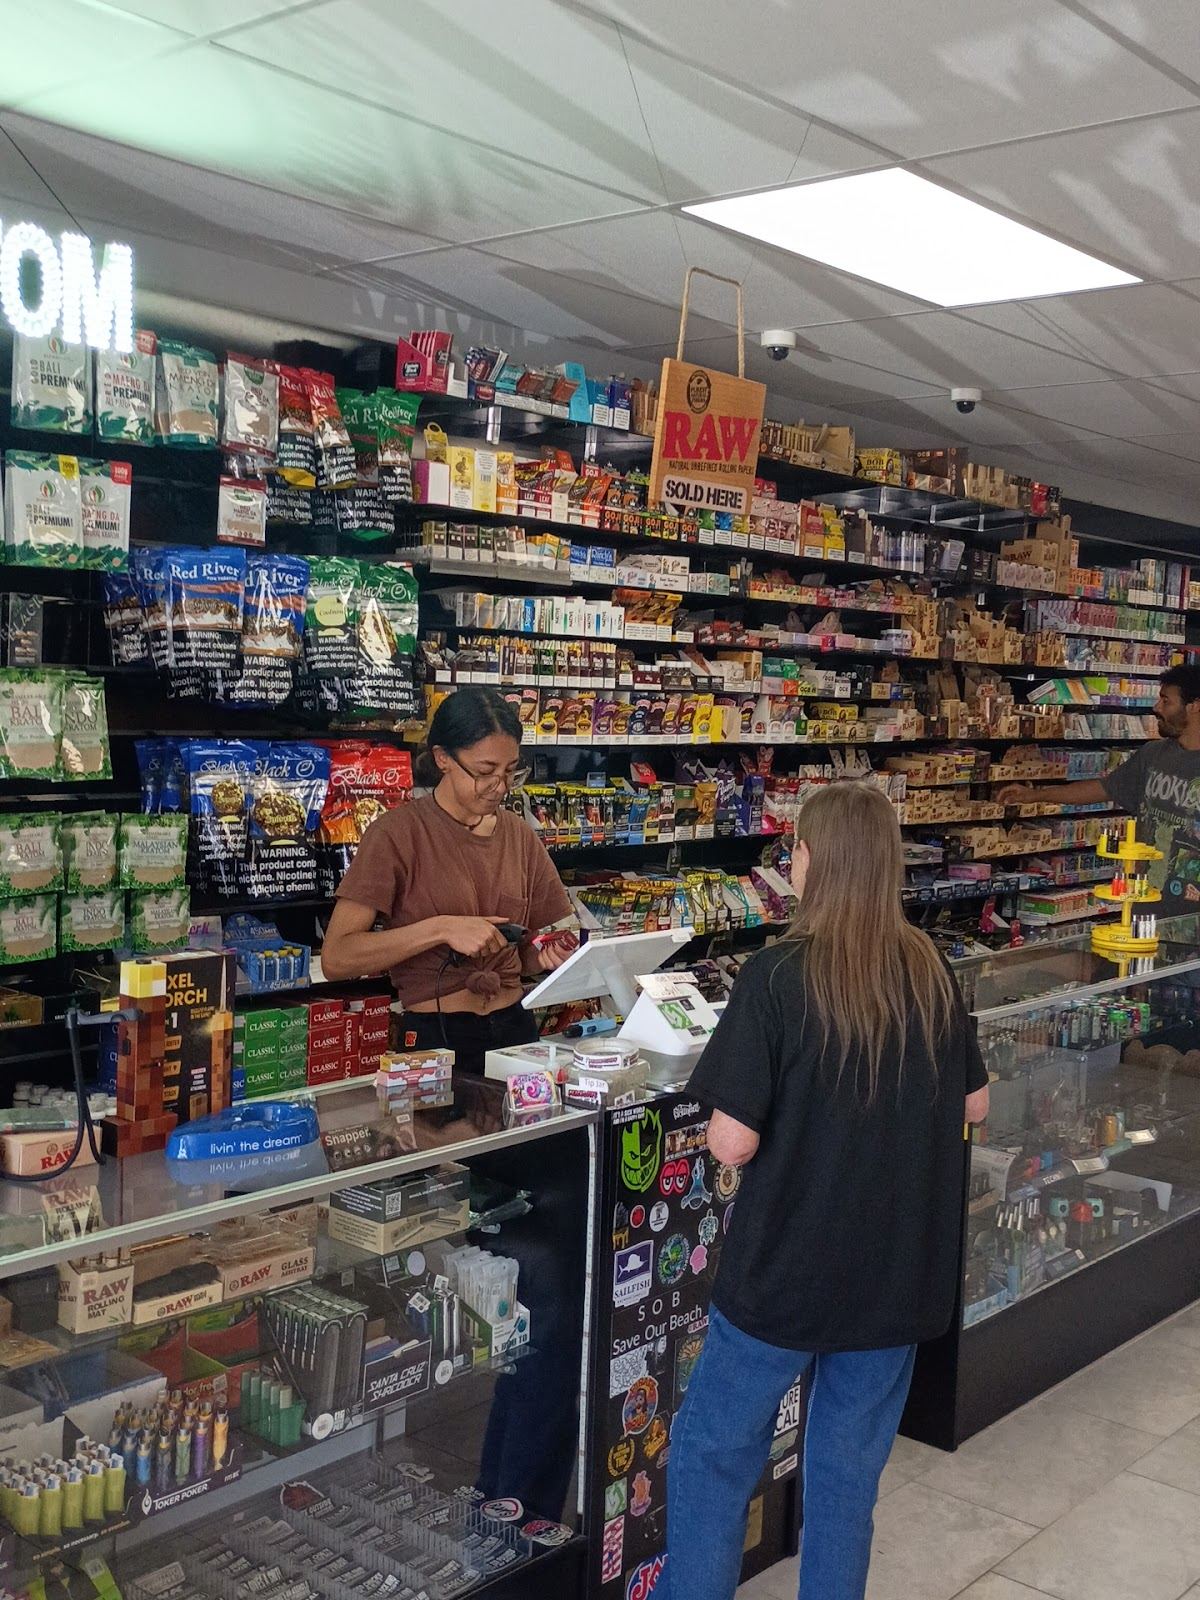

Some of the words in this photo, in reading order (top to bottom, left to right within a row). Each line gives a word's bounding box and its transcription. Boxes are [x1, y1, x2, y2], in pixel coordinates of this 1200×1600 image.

[39, 359, 61, 374] BALI
[343, 408, 359, 424] ed
[296, 436, 313, 444] WARN
[663, 411, 758, 463] RAW
[585, 469, 599, 477] GOJI
[666, 480, 704, 503] SOLD
[707, 487, 744, 510] HERE
[110, 511, 120, 521] DA
[1010, 551, 1033, 562] RAW
[172, 564, 198, 579] Red
[202, 562, 240, 576] River
[360, 580, 386, 598] lack
[244, 656, 287, 667] WARNING:
[243, 668, 273, 677] product
[64, 712, 98, 725] NDO
[331, 768, 381, 787] Black
[133, 841, 178, 849] MALAYSIAN
[260, 848, 308, 859] WARNING:
[259, 860, 294, 872] product
[276, 871, 312, 881] Nicotine
[247, 885, 283, 895] addictive
[167, 972, 194, 990] XEL
[166, 988, 207, 1007] ORCH
[314, 1011, 340, 1022] CLASSIC
[365, 1006, 390, 1016] CLASSIC
[250, 1020, 277, 1031] CLASSIC
[281, 1017, 307, 1028] CLASSIC
[363, 1030, 388, 1040] CLASSIC
[313, 1036, 339, 1048] CLASSIC
[248, 1046, 275, 1057] CLASSIC
[280, 1043, 306, 1054] CLASSIC
[361, 1055, 381, 1064] CLASS
[311, 1061, 338, 1073] CLASSIC
[247, 1072, 274, 1083] CLASSIC
[279, 1068, 306, 1080] CLASSIC
[585, 1078, 594, 1087] Tip
[596, 1080, 605, 1088] Jar
[324, 1127, 372, 1148] Snapper.
[210, 1142, 236, 1154] livin'
[240, 1141, 260, 1151] the
[263, 1135, 300, 1149] dream
[41, 1149, 78, 1170] RAW
[240, 1265, 272, 1288] RAW
[281, 1256, 309, 1271] GLASS
[57, 1281, 70, 1294] AW
[83, 1277, 130, 1305] RAW
[614, 1279, 651, 1298] SAILFISH
[87, 1295, 125, 1313] ROLLING
[165, 1295, 193, 1314] RAW
[638, 1305, 646, 1322] S
[652, 1299, 663, 1315] O
[672, 1291, 681, 1308] B
[612, 1334, 641, 1356] Save
[644, 1322, 667, 1341] Our
[669, 1304, 702, 1331] Beach
[367, 1373, 398, 1393] SANTA
[399, 1361, 427, 1380] CRUZ
[154, 1495, 180, 1511] TOKER
[181, 1483, 208, 1500] POKER
